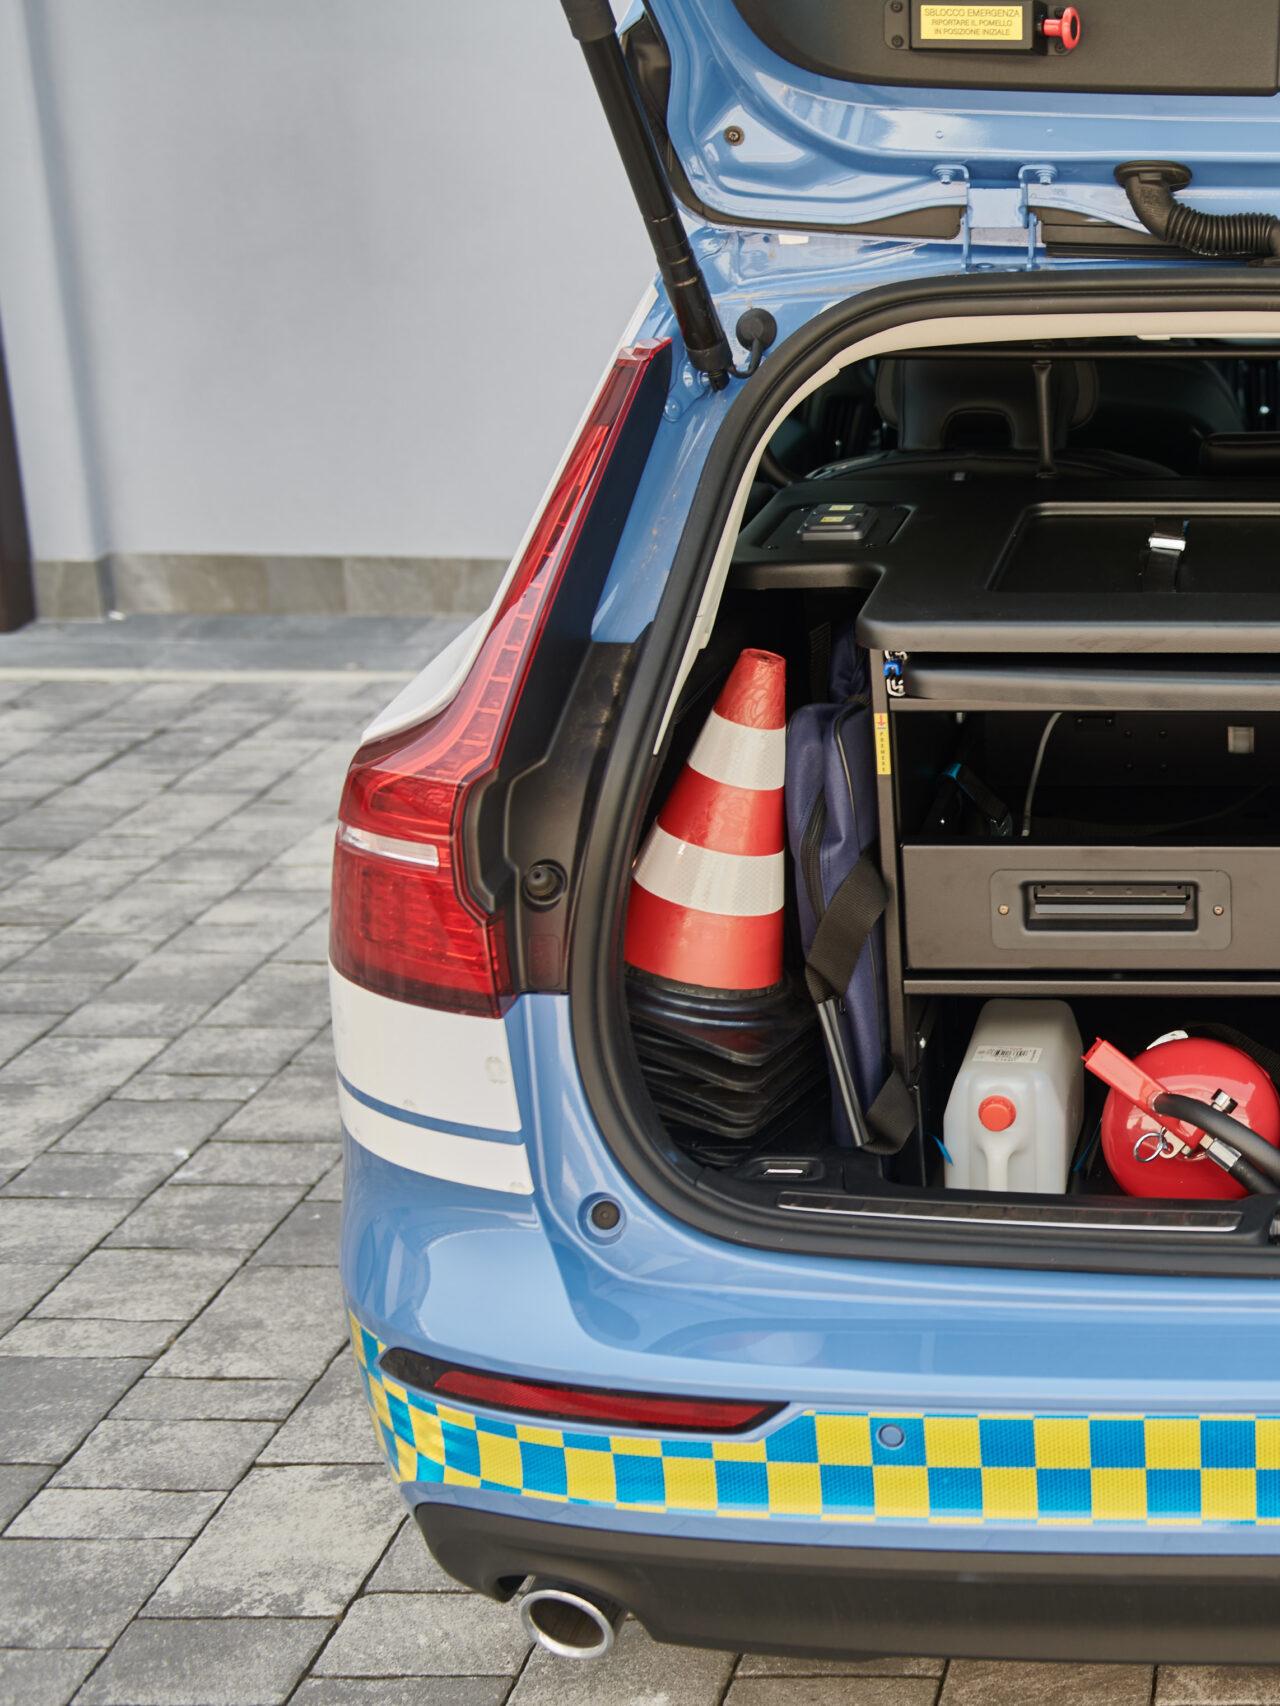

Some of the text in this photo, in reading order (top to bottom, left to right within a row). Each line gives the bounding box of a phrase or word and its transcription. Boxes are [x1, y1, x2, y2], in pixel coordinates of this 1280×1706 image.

[924, 8, 1020, 17] SBLOCCO EMERGENZA
[971, 19, 978, 27] IL
[979, 19, 1013, 27] POMELLO
[943, 28, 981, 36] POSIZIONE
[982, 28, 1011, 36] INIZIALE
